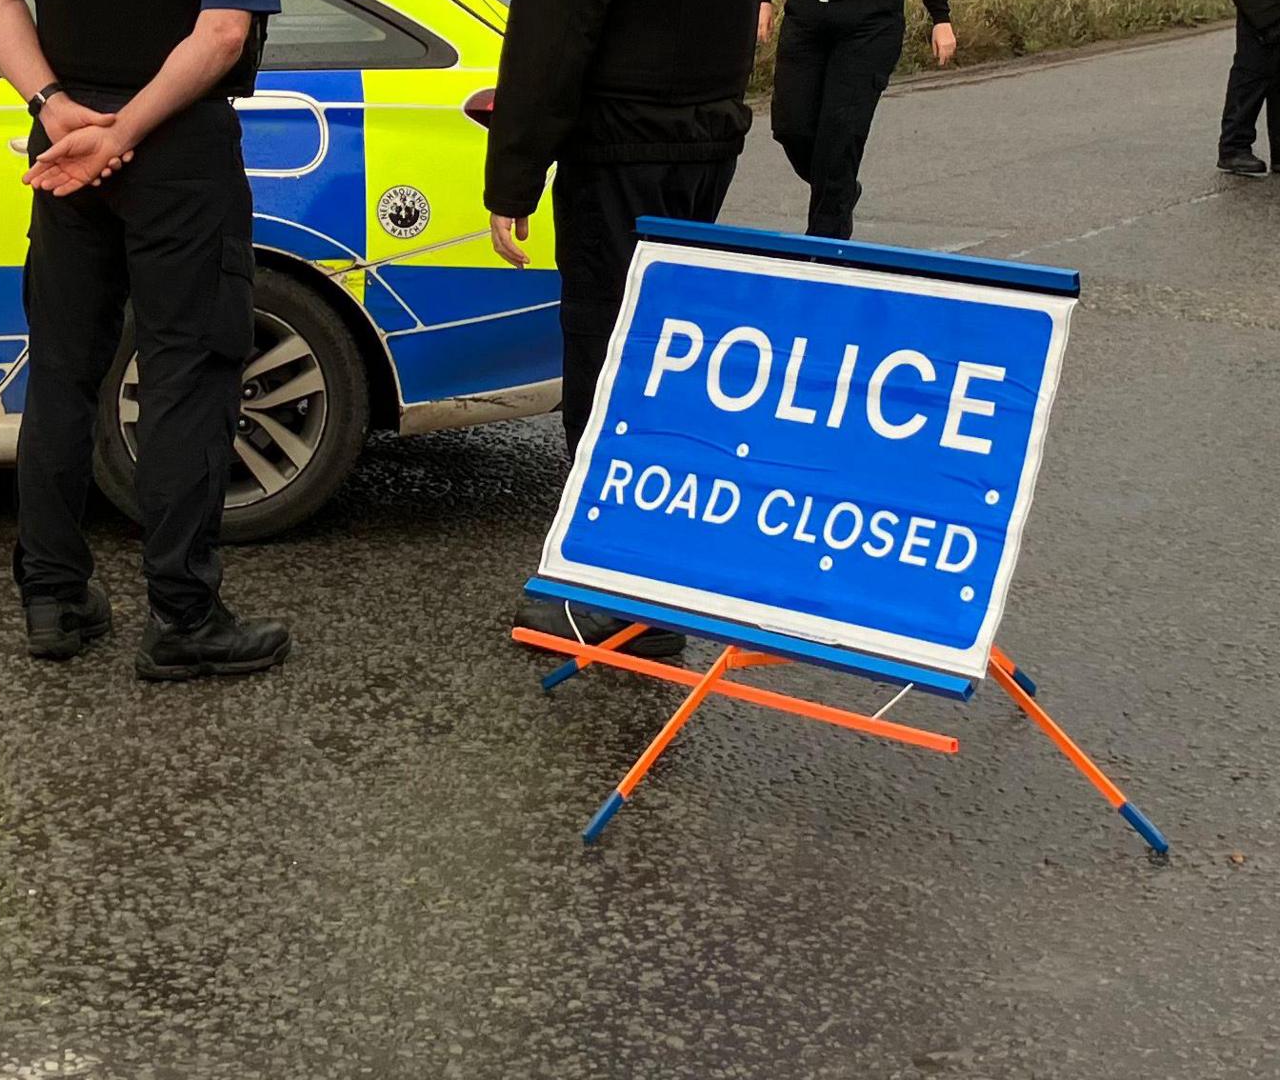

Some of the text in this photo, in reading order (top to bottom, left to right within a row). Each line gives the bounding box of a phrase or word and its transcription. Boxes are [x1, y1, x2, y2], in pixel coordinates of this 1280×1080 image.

[379, 187, 428, 221] NEIGHBOURHOOD
[391, 225, 420, 237] WATCH
[643, 317, 1007, 456] POLICE
[599, 458, 979, 575] ROAD CLOSED
